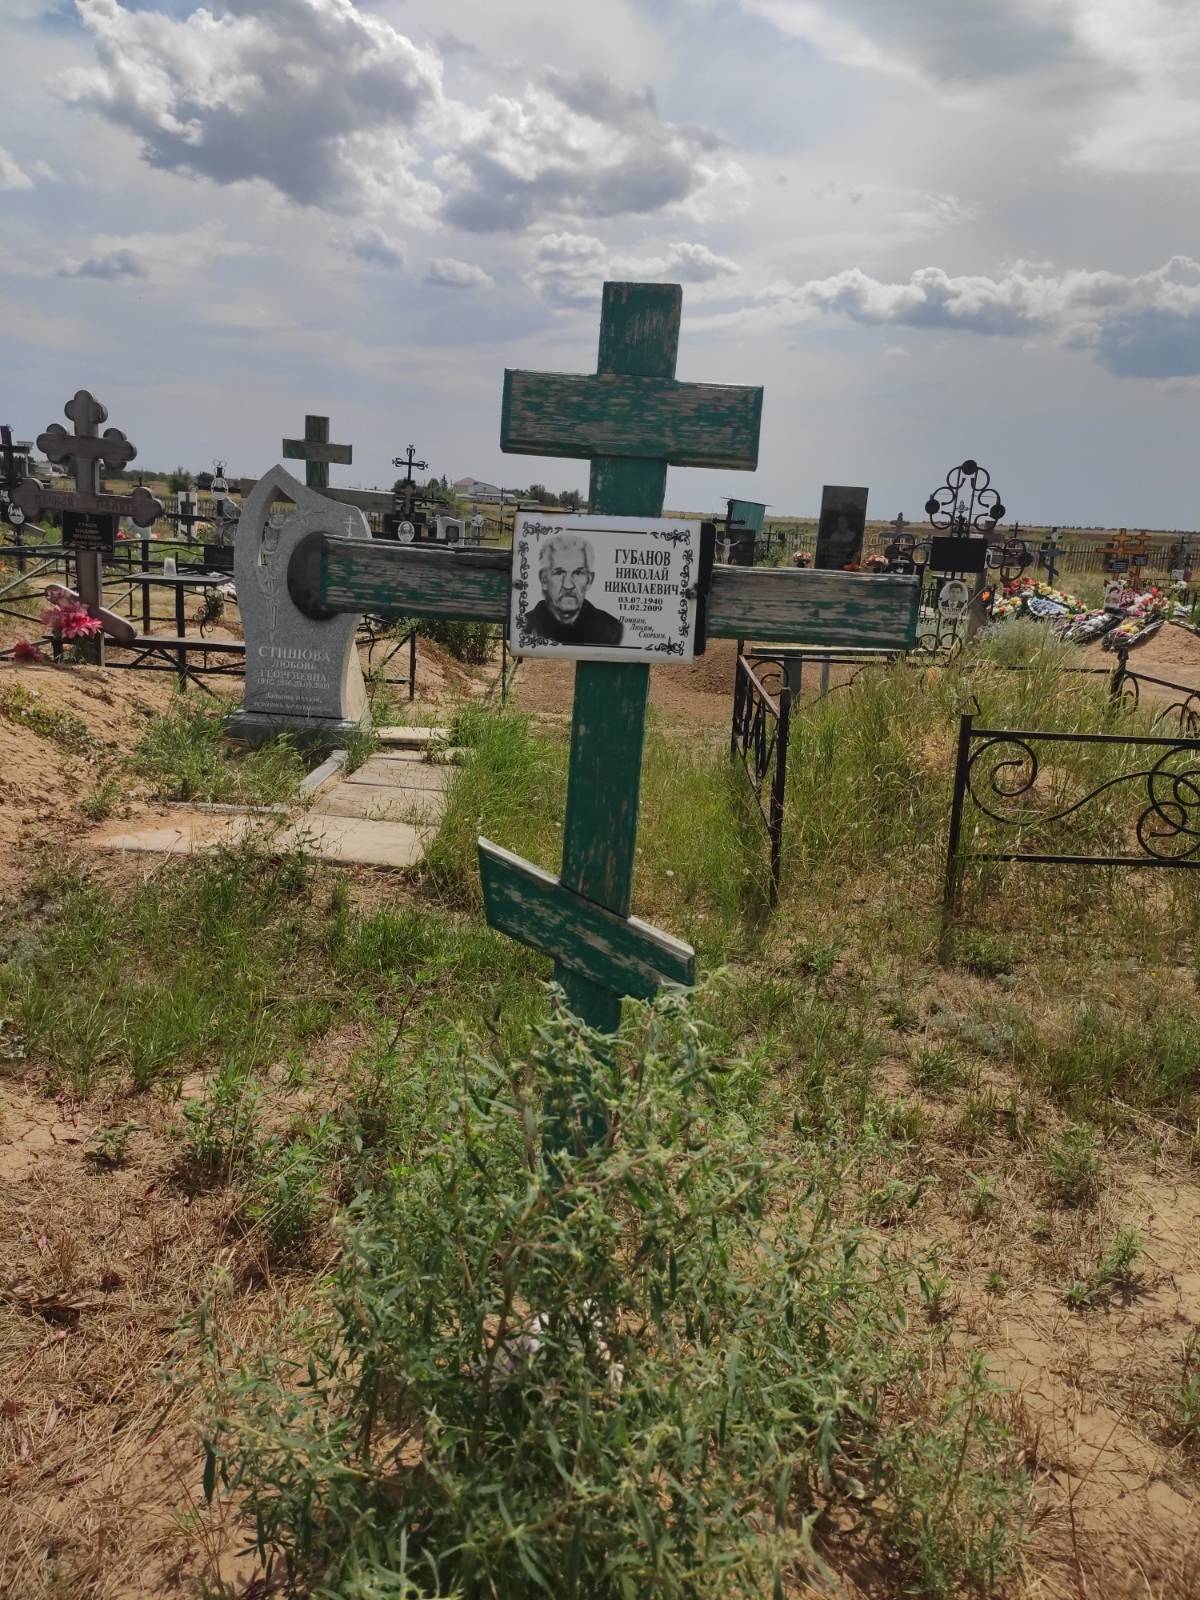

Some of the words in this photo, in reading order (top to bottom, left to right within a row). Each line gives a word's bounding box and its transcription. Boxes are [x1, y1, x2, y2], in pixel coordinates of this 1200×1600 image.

[615, 548, 671, 566] ГУБАНОВ
[615, 567, 669, 581] НИКОЛАЙ
[604, 581, 679, 596] НИКОЛАЕВИЧ
[618, 597, 663, 605] 03.07.1940
[619, 604, 663, 612] 11.02.2009
[271, 659, 318, 670] ЛЮБОВЬ
[259, 669, 327, 682] ГЕОРГИЕВНА
